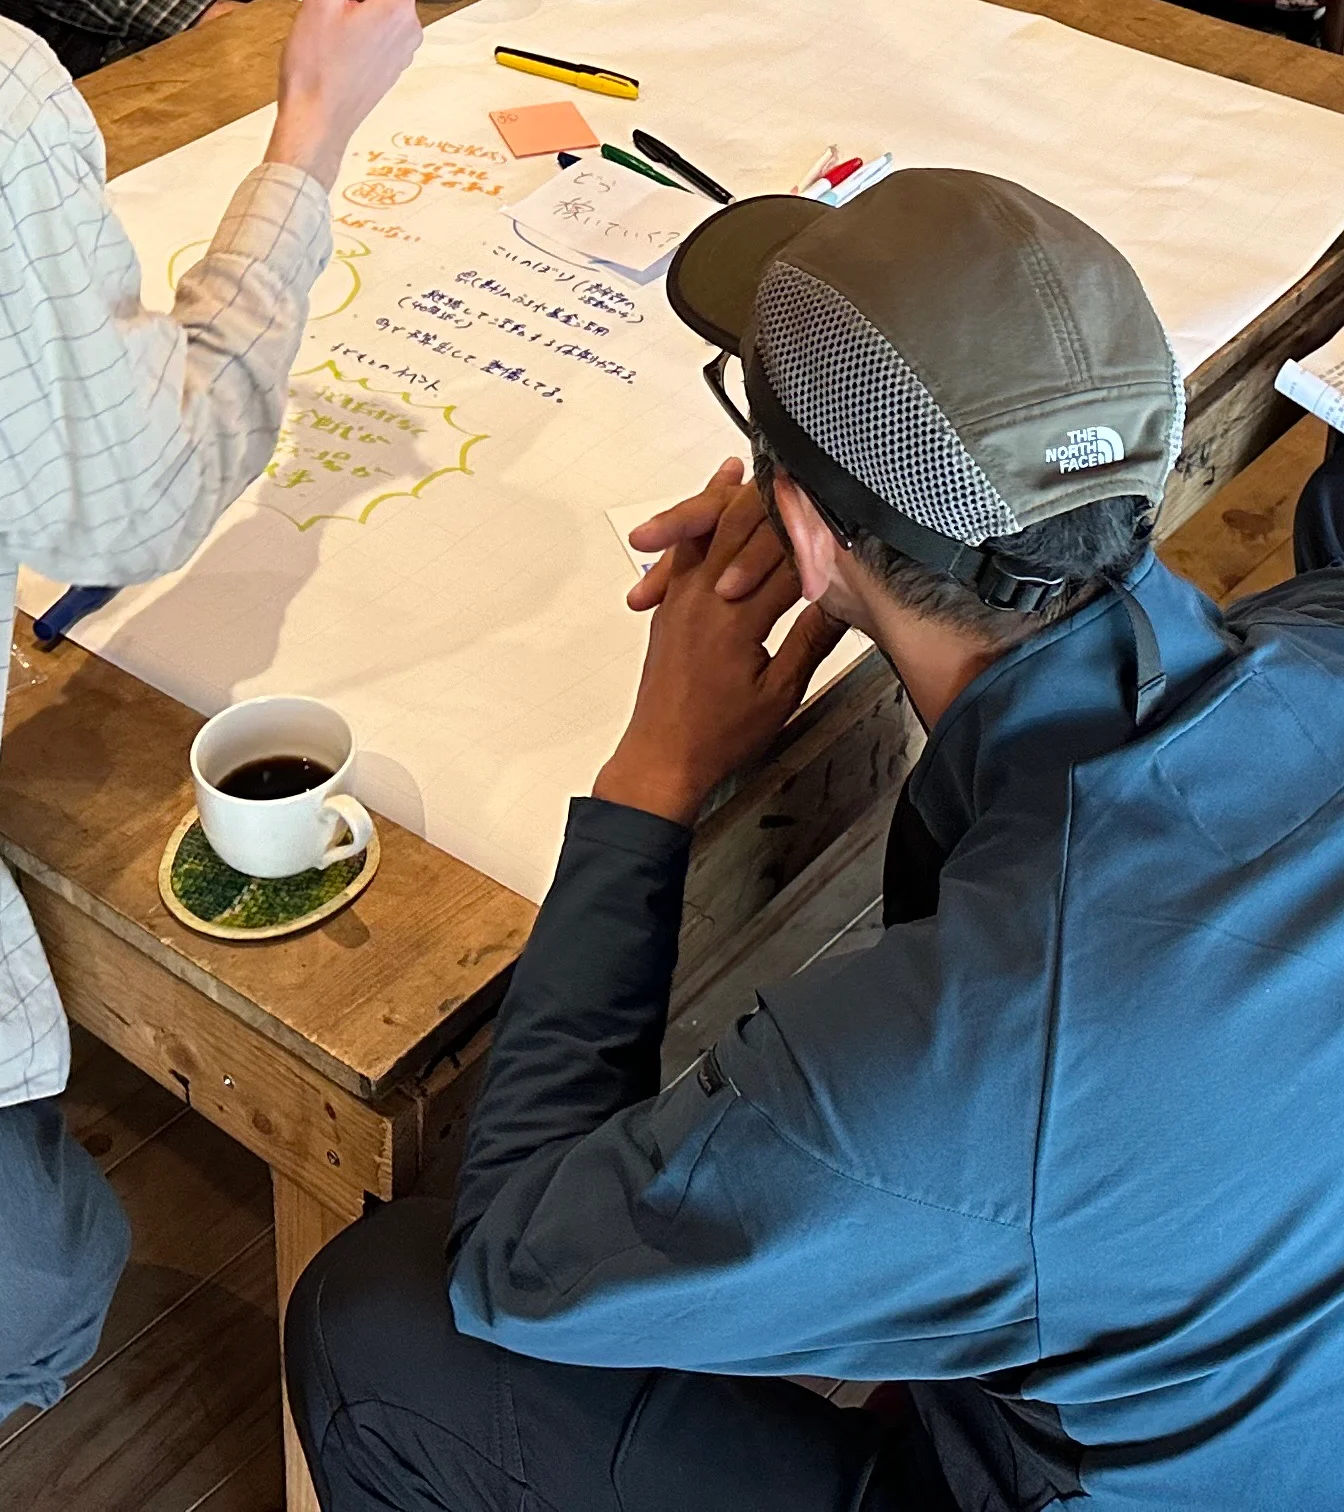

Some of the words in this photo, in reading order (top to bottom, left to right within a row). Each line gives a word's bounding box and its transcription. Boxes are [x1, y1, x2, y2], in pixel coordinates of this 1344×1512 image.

[1067, 427, 1097, 444] THE
[1045, 441, 1097, 463] NORTH
[1059, 453, 1098, 474] FACE
